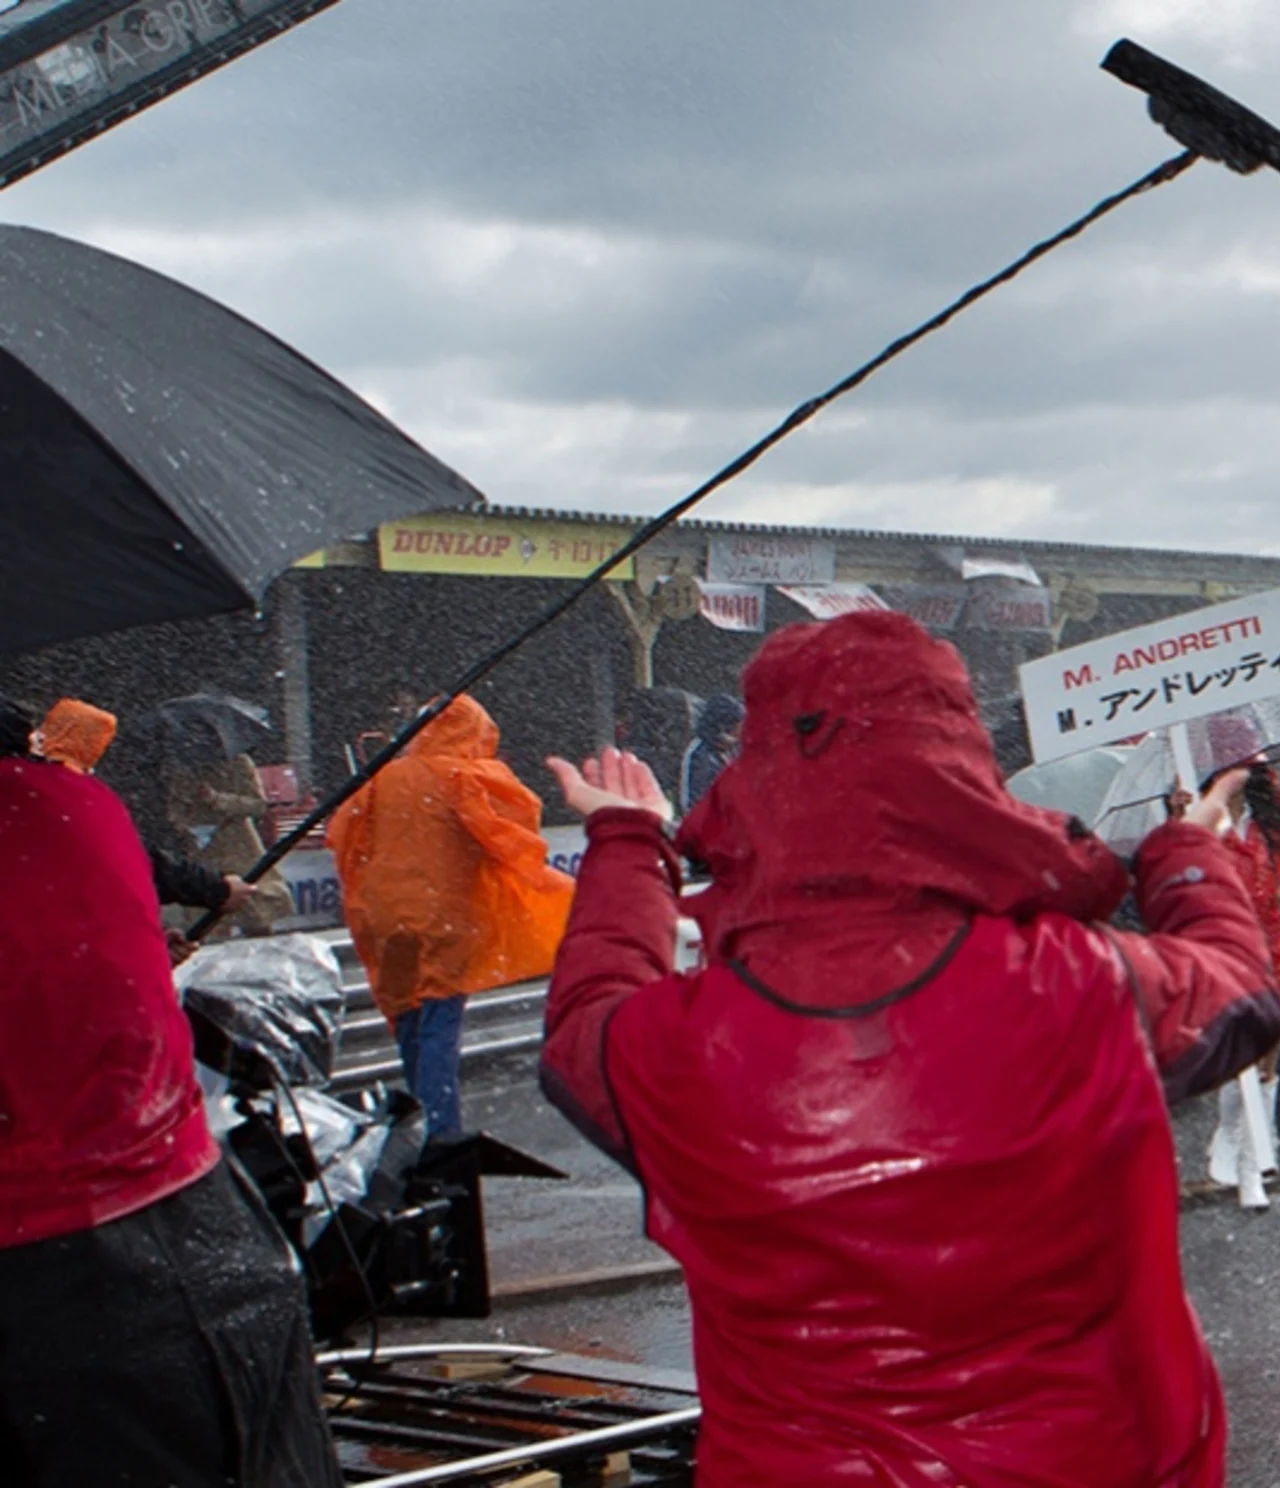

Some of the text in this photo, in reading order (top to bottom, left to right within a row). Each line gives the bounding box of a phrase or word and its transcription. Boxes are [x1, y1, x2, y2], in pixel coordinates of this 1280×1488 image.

[392, 529, 512, 558] DUNLOP
[1063, 616, 1262, 690] M. ANDRETTI
